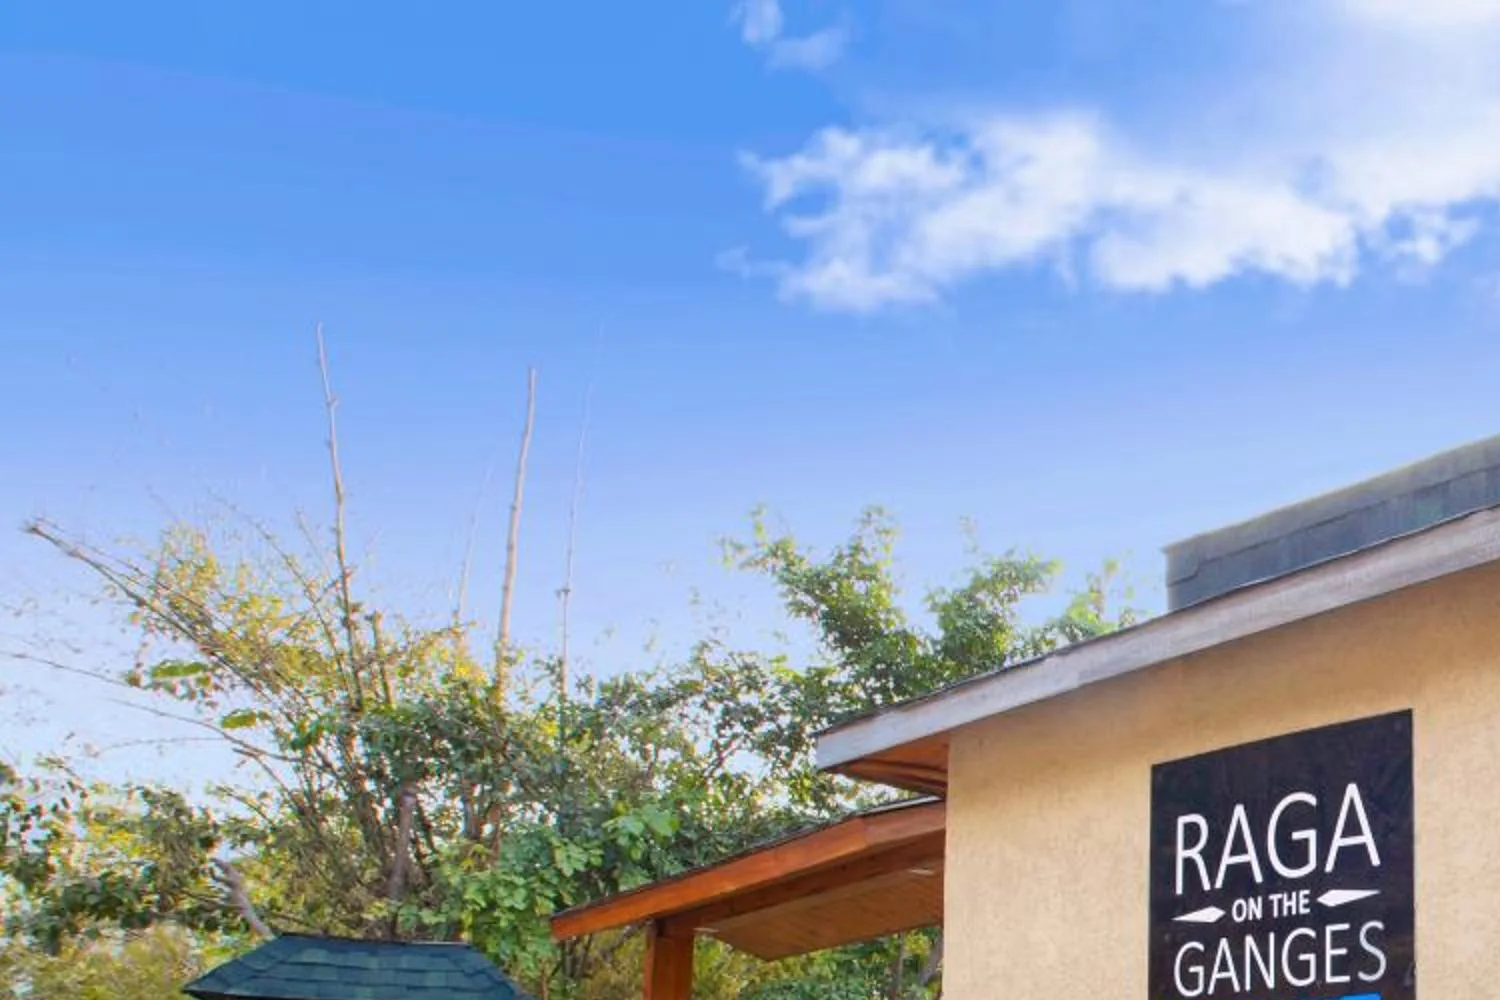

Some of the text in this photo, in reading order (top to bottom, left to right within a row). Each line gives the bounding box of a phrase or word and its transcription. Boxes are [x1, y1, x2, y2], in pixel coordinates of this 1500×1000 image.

[1174, 783, 1381, 895] RAGA
[1231, 889, 1311, 922] ON THE
[1173, 920, 1387, 997] GANGES
